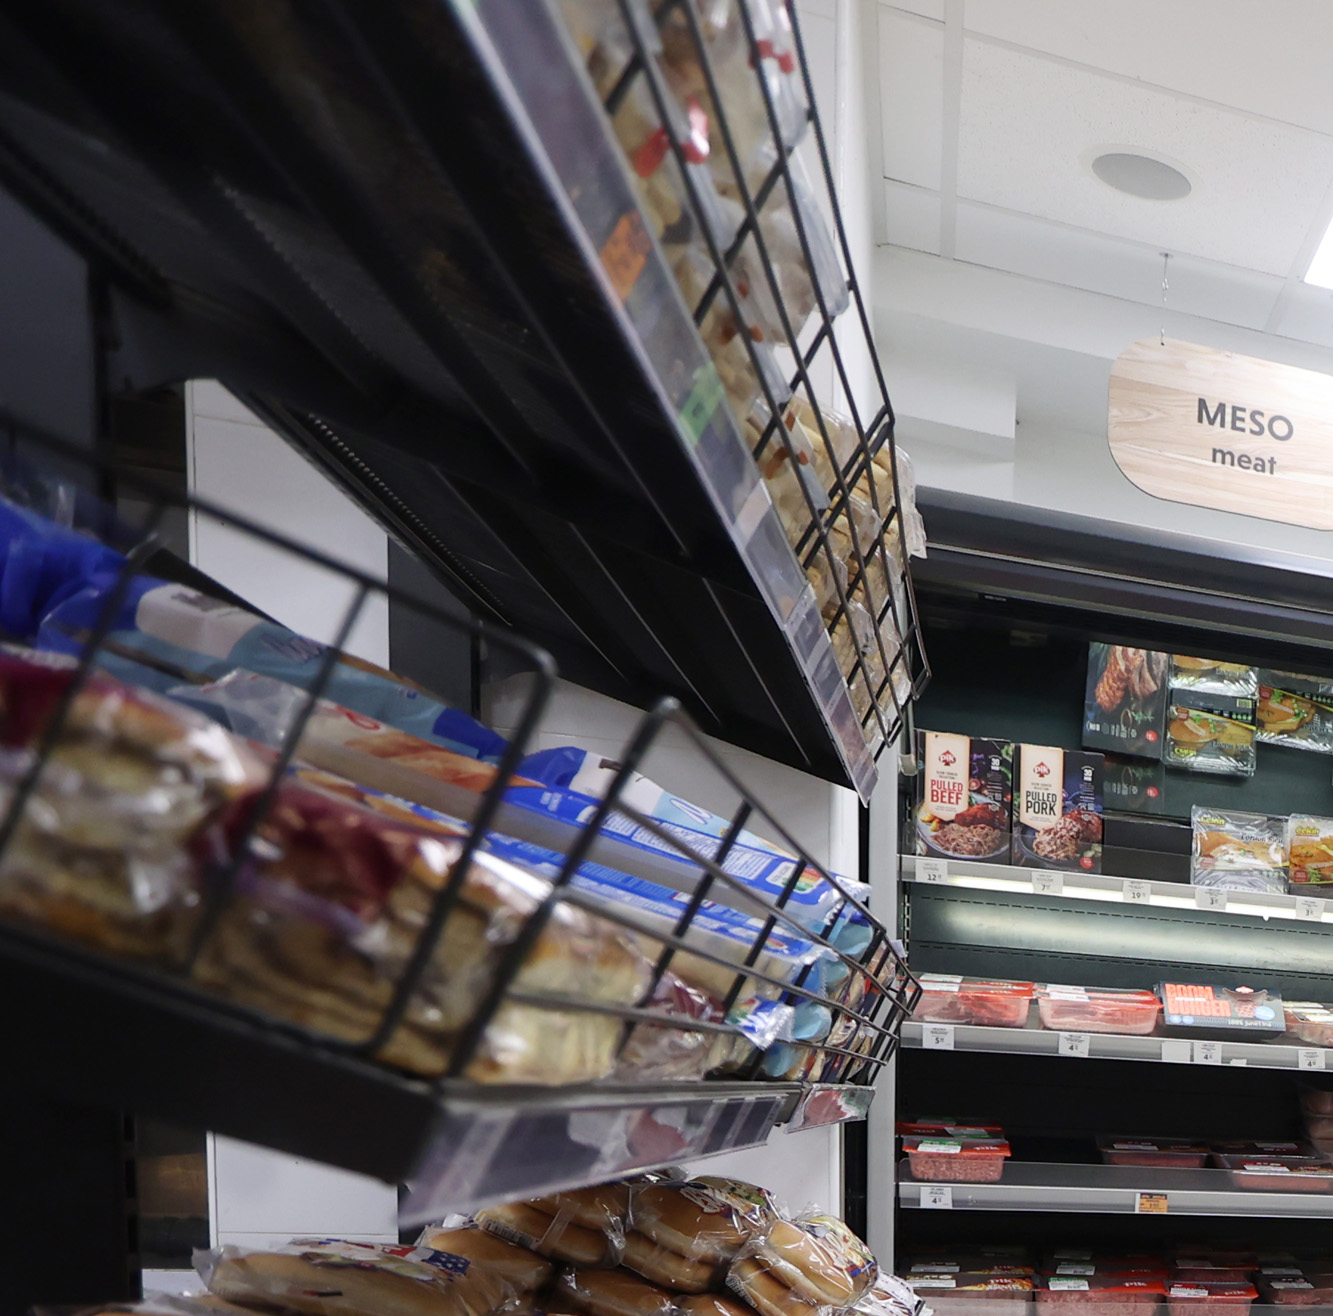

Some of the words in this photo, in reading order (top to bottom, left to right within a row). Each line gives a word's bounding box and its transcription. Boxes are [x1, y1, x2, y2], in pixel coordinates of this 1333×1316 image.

[1197, 397, 1294, 441] MESO
[1212, 447, 1277, 475] meat
[930, 779, 964, 792] PULLED
[930, 789, 963, 805] BEEF
[1025, 790, 1058, 803] PULLED
[1025, 800, 1057, 816] PORK
[1295, 826, 1320, 835] Cekin
[1164, 983, 1215, 1000] BOOM
[1167, 999, 1232, 1017] BURGER
